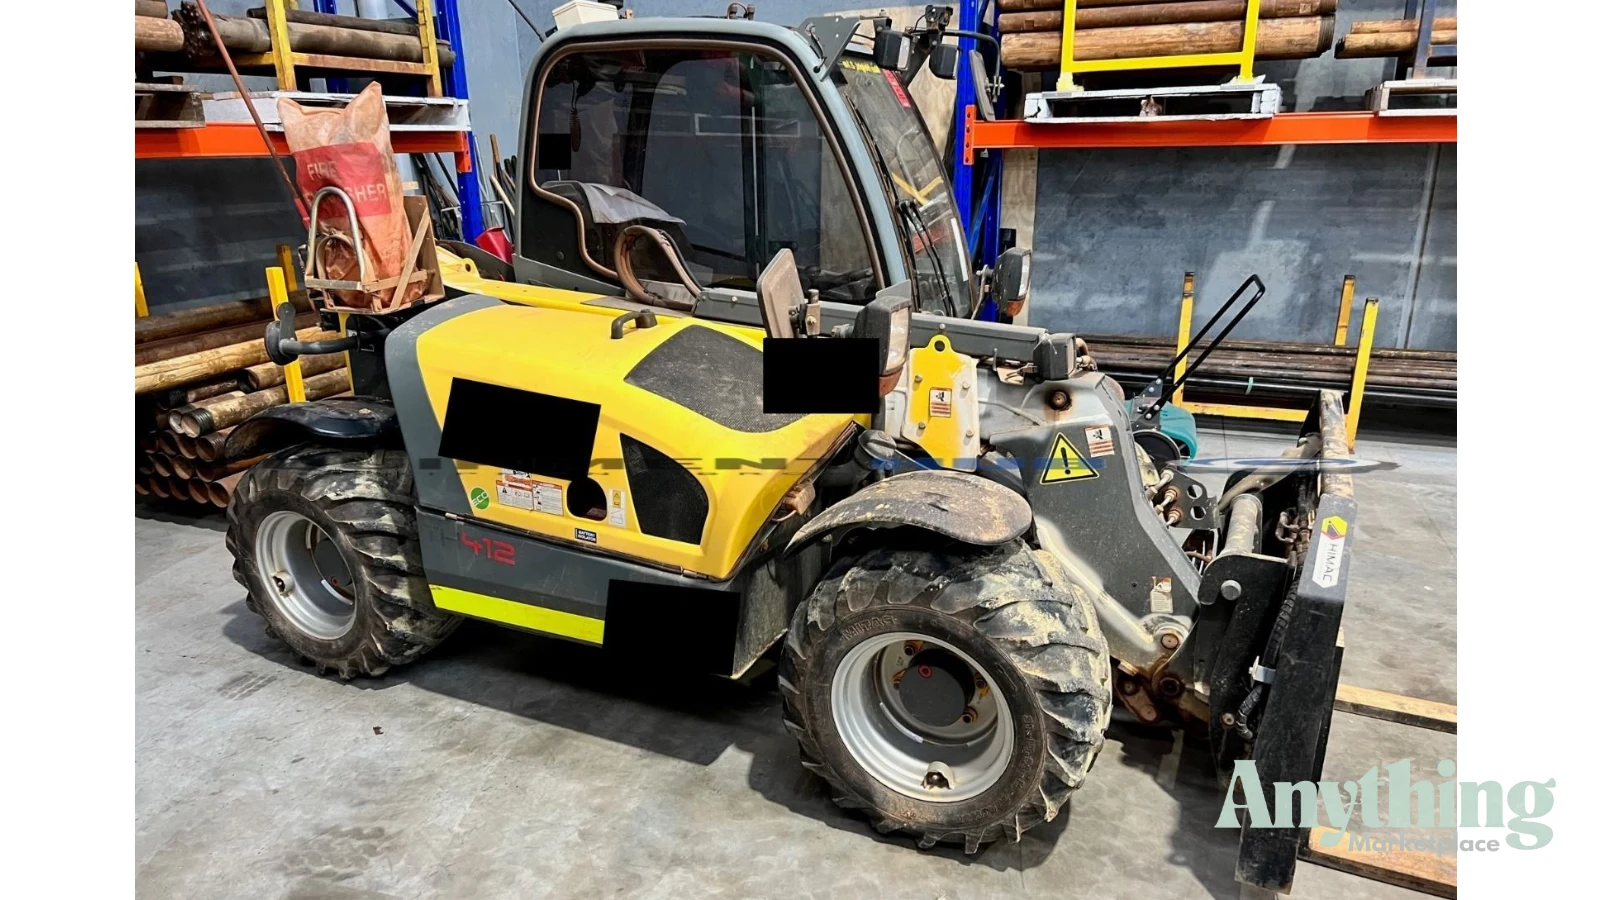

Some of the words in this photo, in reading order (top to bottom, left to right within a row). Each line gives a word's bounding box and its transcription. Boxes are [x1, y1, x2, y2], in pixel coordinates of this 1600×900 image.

[306, 160, 337, 180] FIRE
[471, 491, 489, 506] ECO
[1322, 543, 1338, 582] HIMAC
